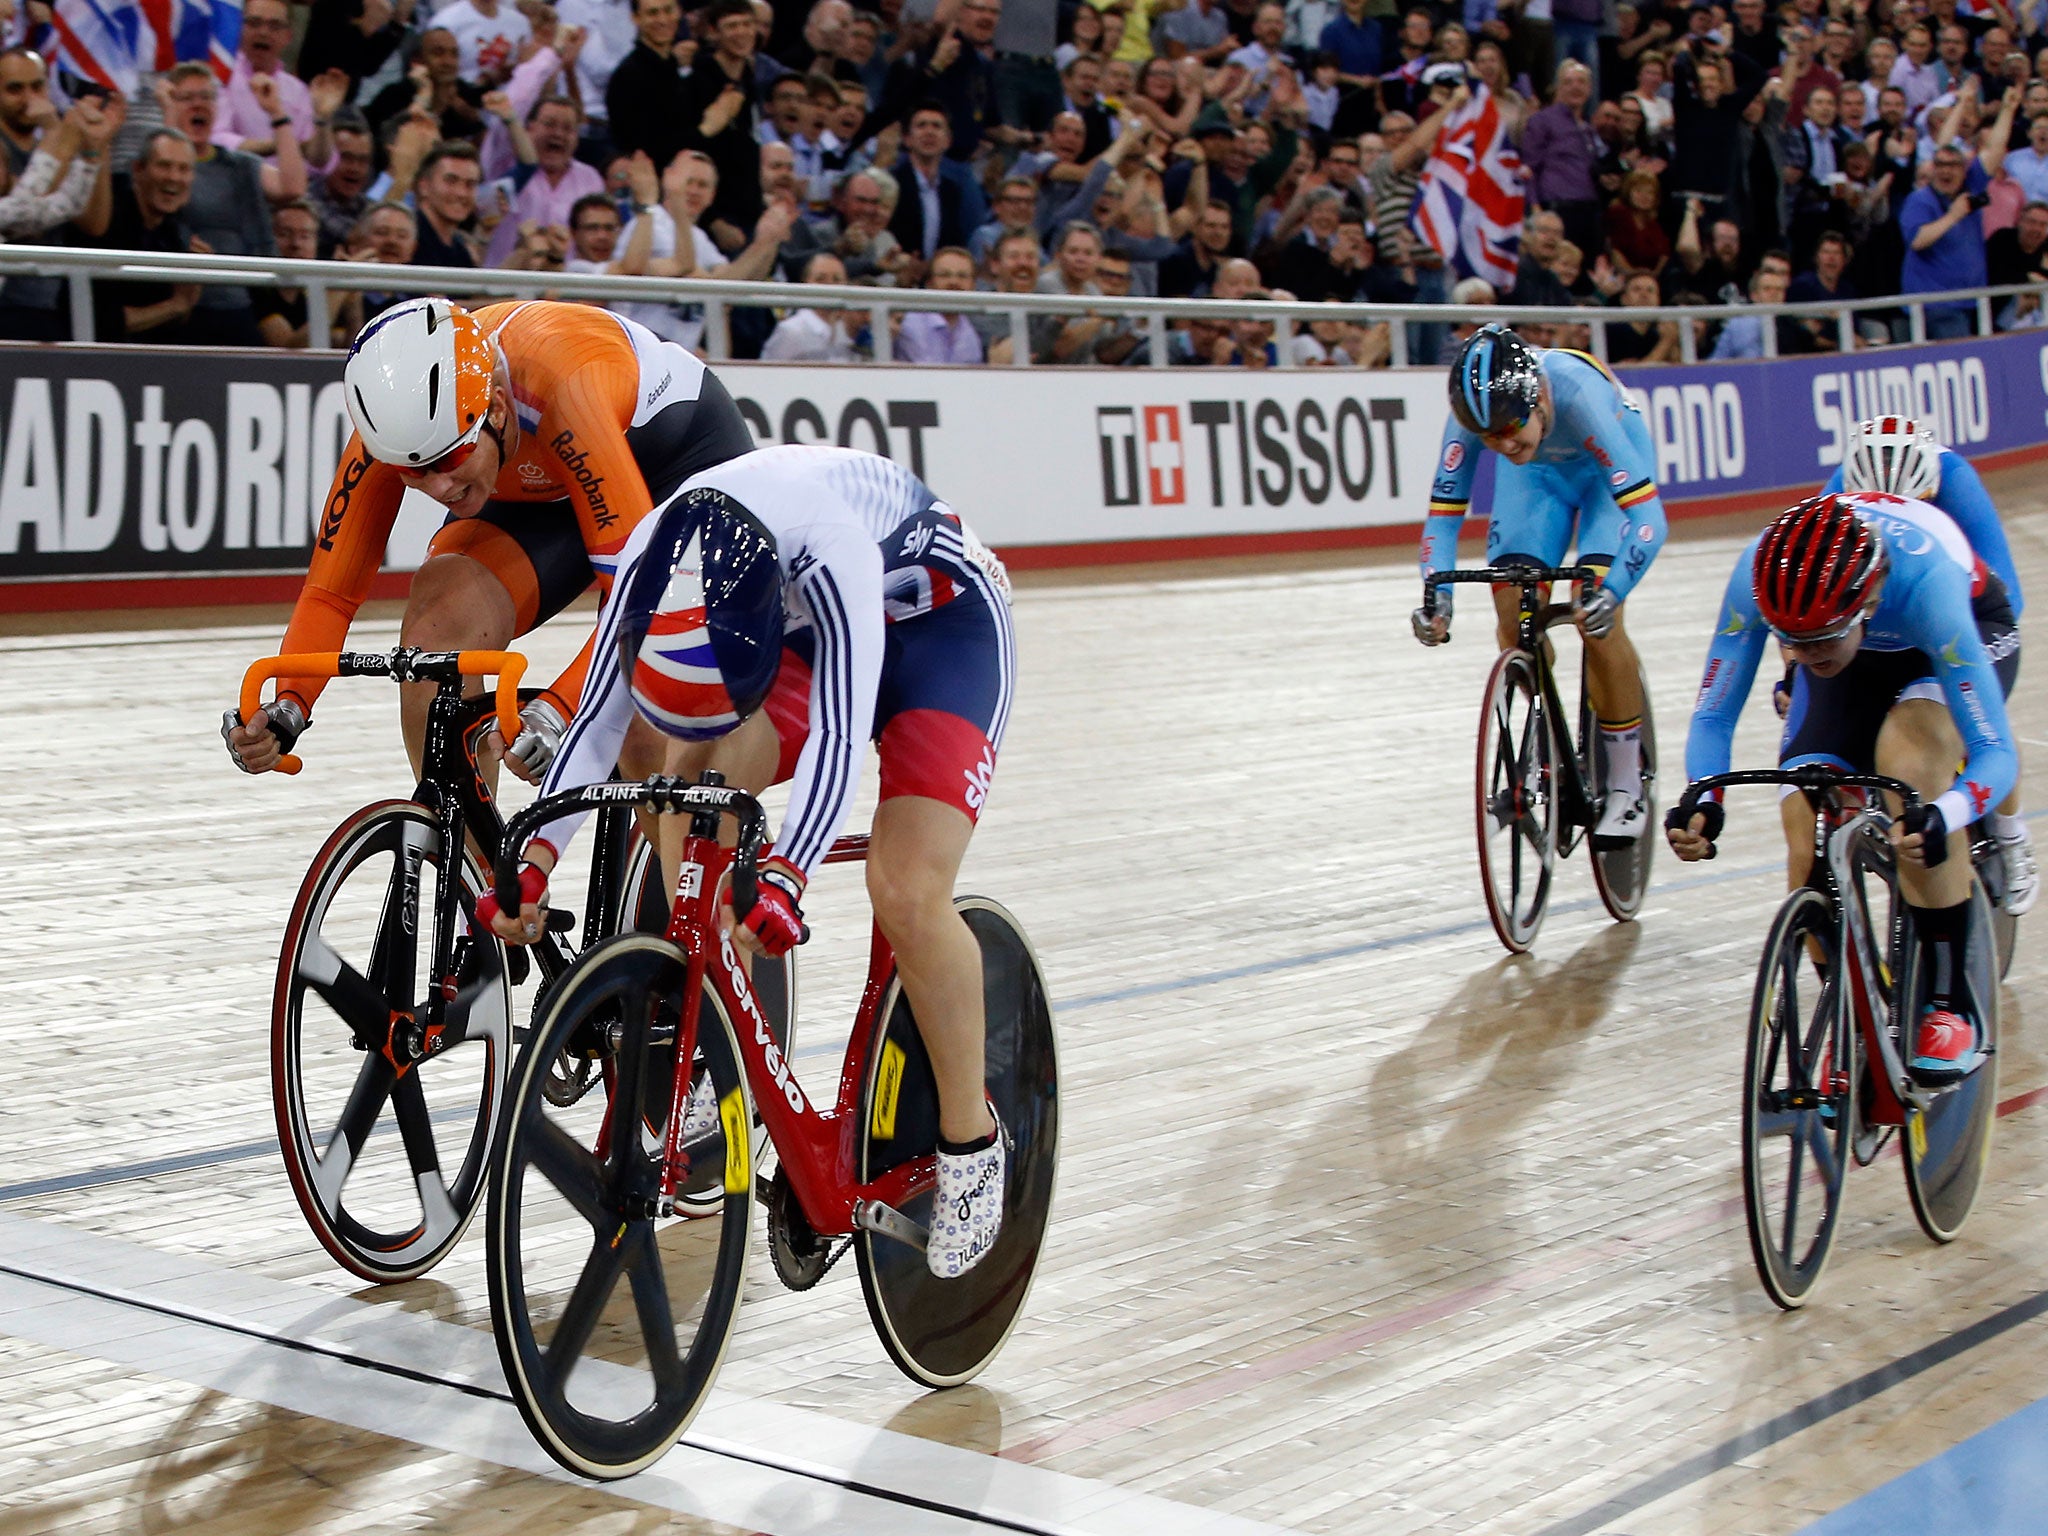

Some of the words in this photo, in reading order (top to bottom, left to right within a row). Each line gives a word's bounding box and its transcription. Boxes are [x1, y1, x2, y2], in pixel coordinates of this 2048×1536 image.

[134, 385, 218, 553] to
[551, 429, 619, 531] Rabobank
[1190, 397, 1406, 507] TISSOT
[899, 521, 934, 558] sky
[580, 786, 639, 801] ALPINA
[682, 788, 735, 805] ALPINA
[963, 745, 994, 818] sky
